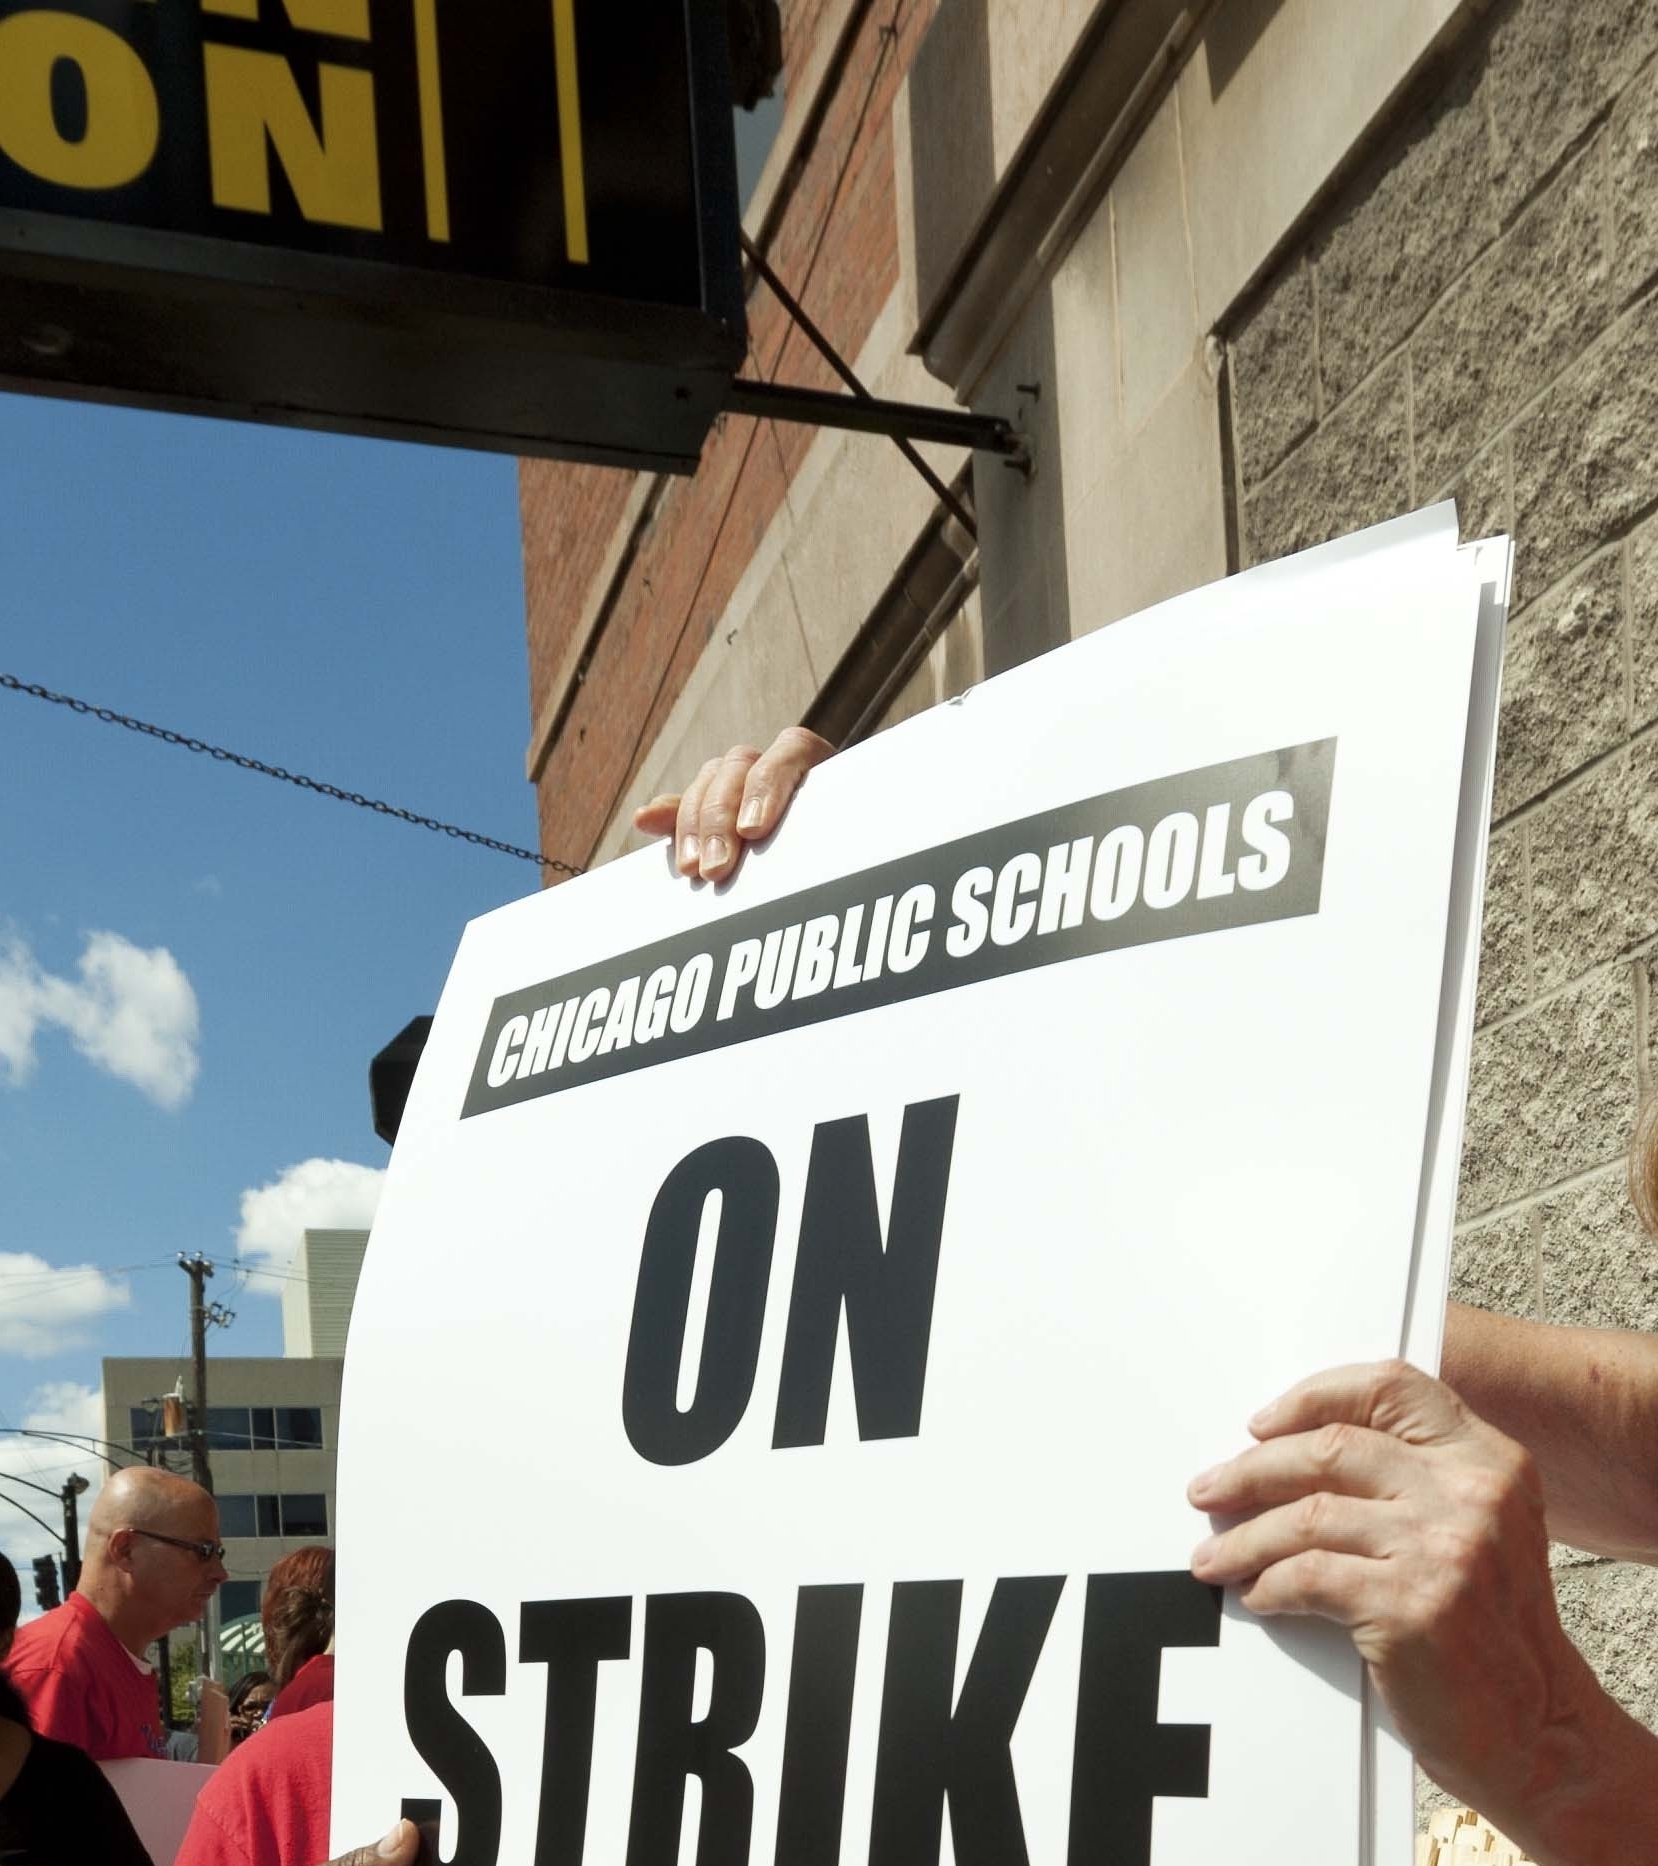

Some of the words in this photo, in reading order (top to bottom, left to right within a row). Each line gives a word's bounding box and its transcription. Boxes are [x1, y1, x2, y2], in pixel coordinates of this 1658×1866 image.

[485, 952, 714, 1089] CHICAGO
[716, 882, 936, 1021] PUBLIC
[946, 788, 1296, 958] SCHOOLS
[622, 1093, 961, 1466] ON
